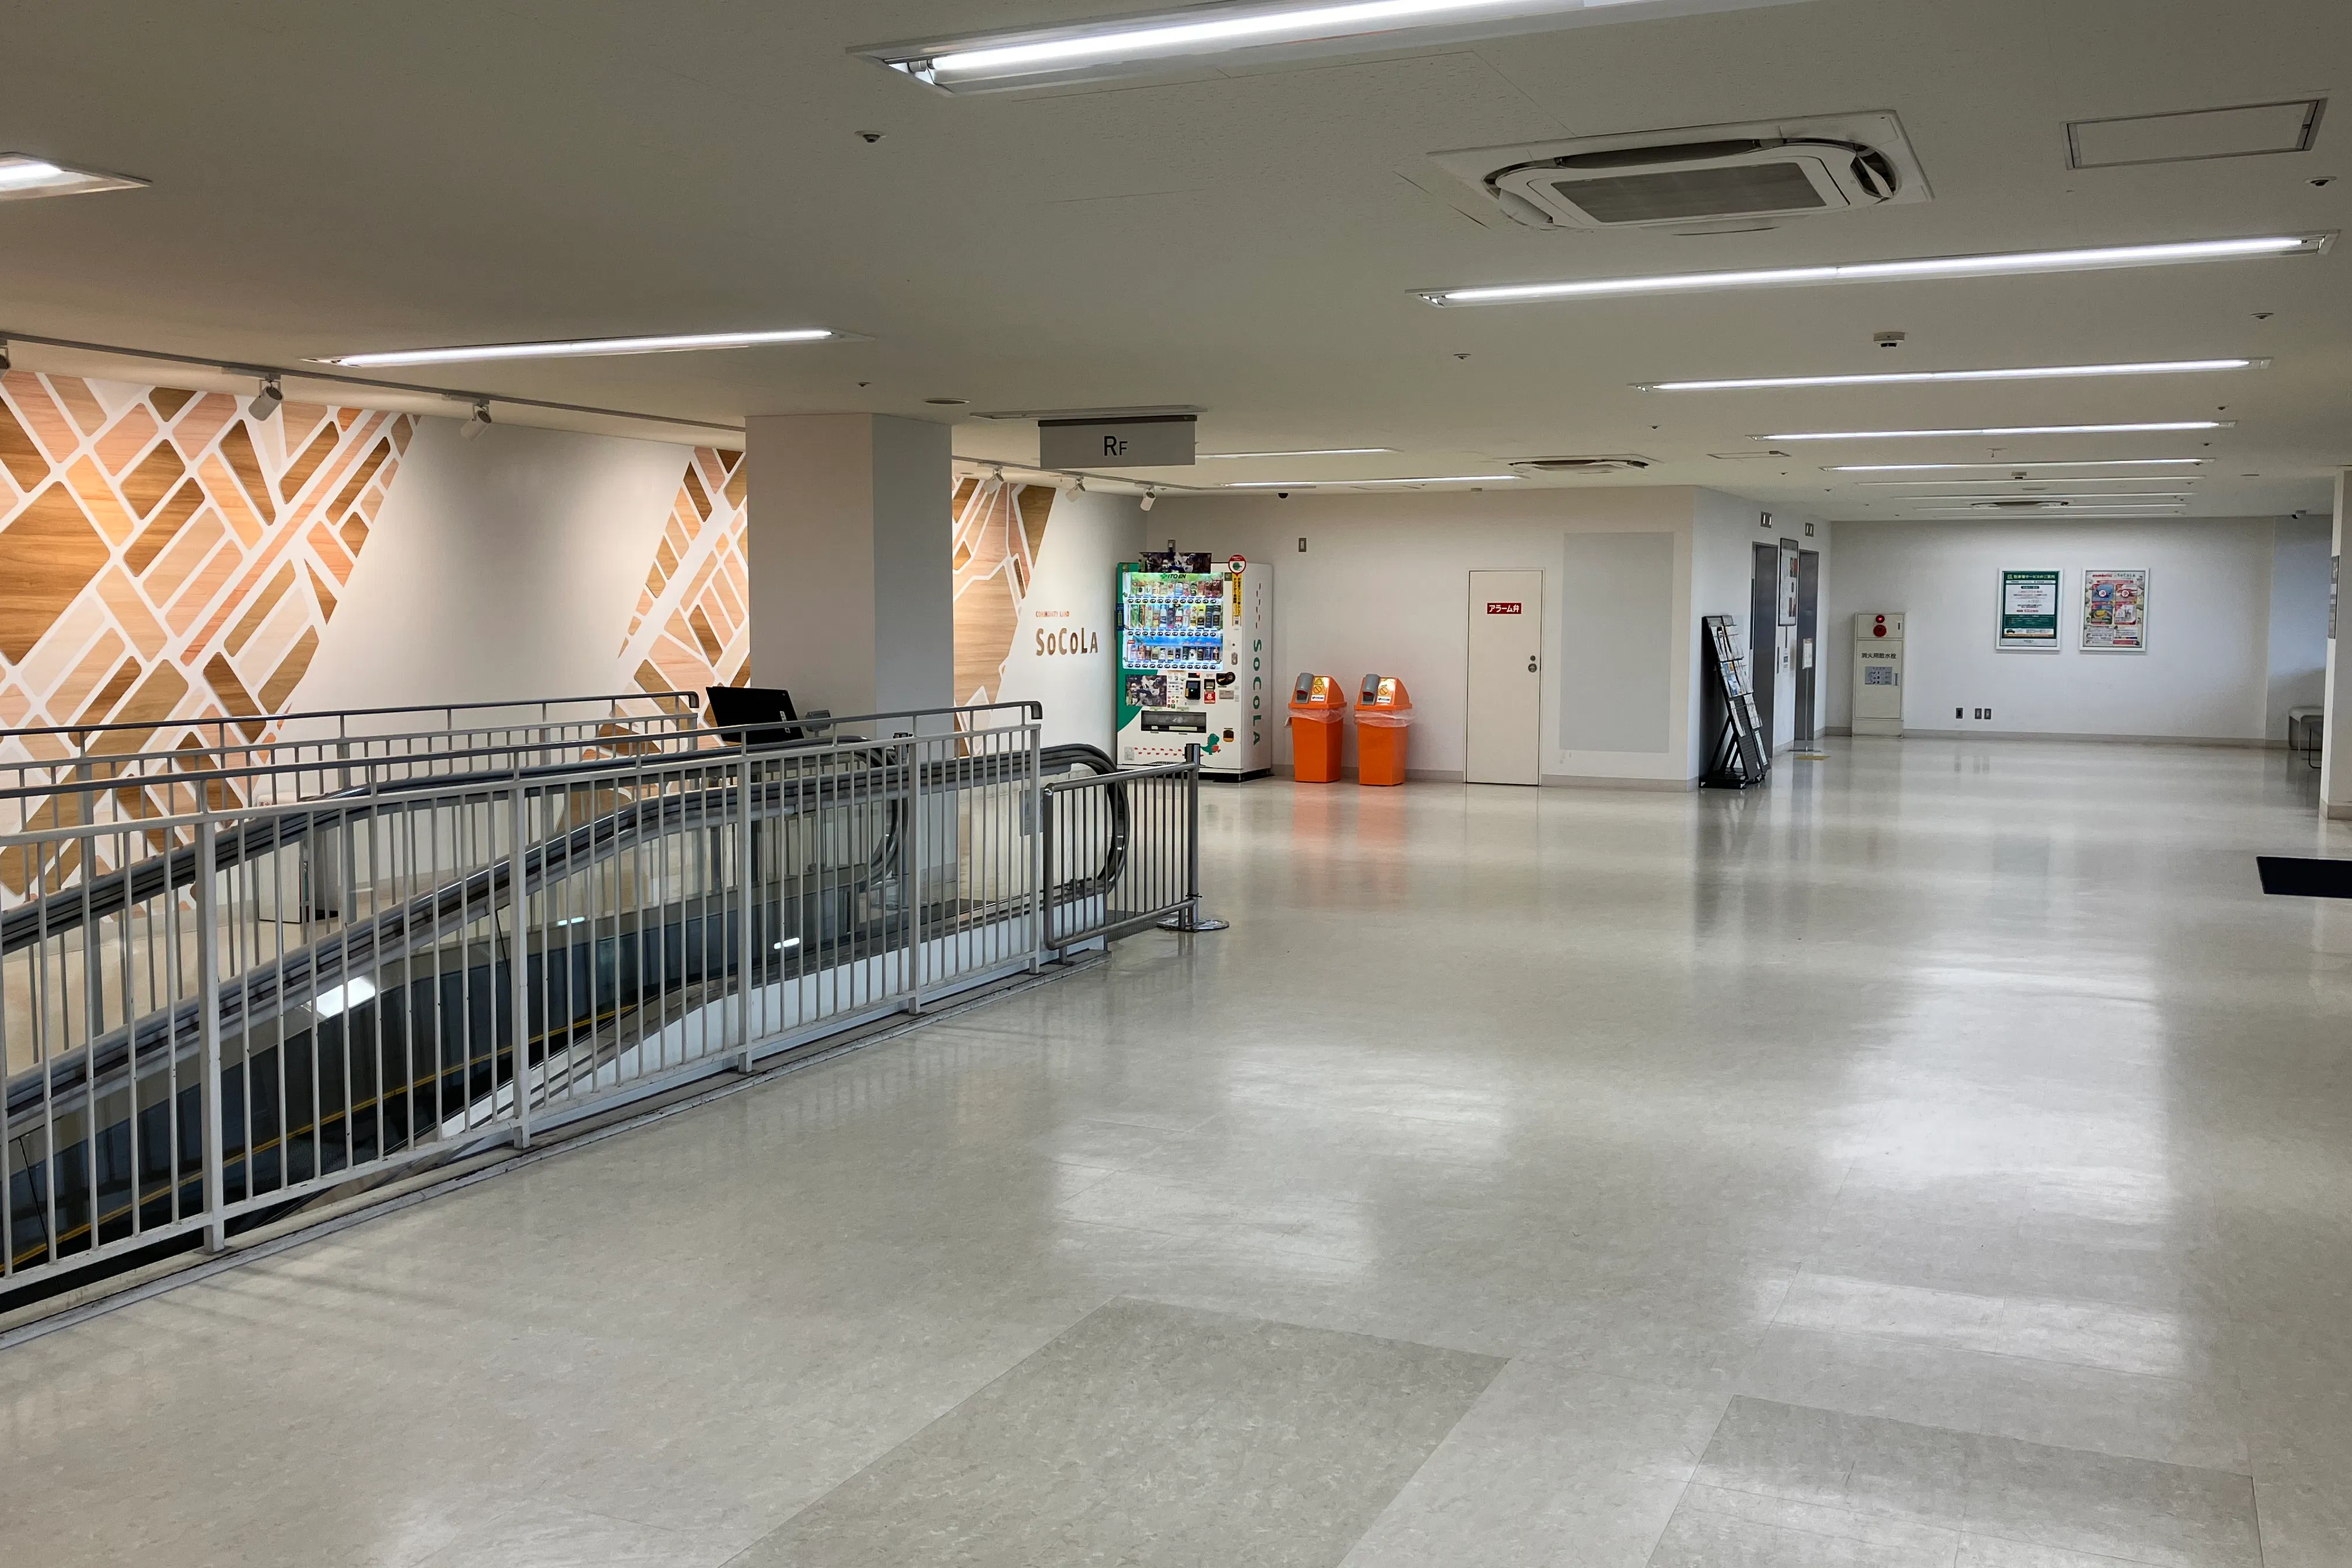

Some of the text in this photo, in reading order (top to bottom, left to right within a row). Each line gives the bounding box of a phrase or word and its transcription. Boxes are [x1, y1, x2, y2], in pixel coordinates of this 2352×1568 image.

[1104, 436, 1128, 456] RF
[1489, 604, 1520, 612] アラーム弁
